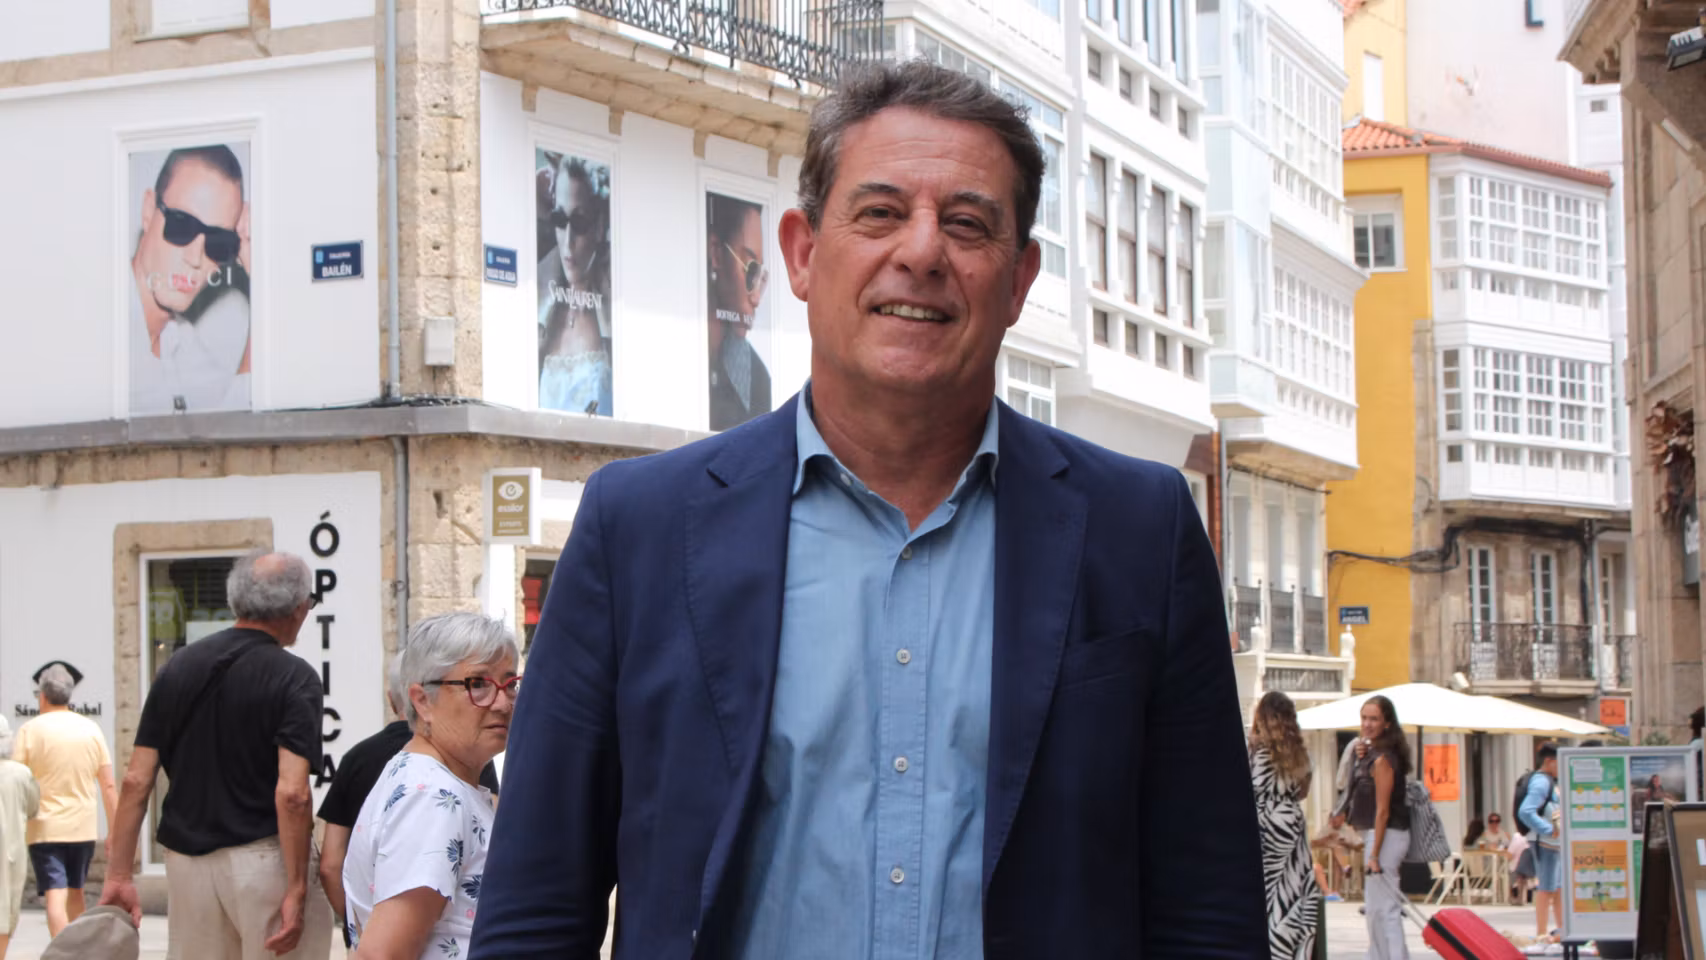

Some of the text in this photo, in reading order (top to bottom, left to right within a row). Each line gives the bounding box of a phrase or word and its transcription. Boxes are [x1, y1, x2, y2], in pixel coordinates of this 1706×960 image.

[321, 262, 352, 277] BAILÉN
[146, 265, 232, 289] GUCCI
[716, 309, 740, 322] BOTTEGA
[497, 504, 524, 512] essilor
[310, 509, 342, 789] ÓPTICA
[1574, 856, 1604, 865] NON
